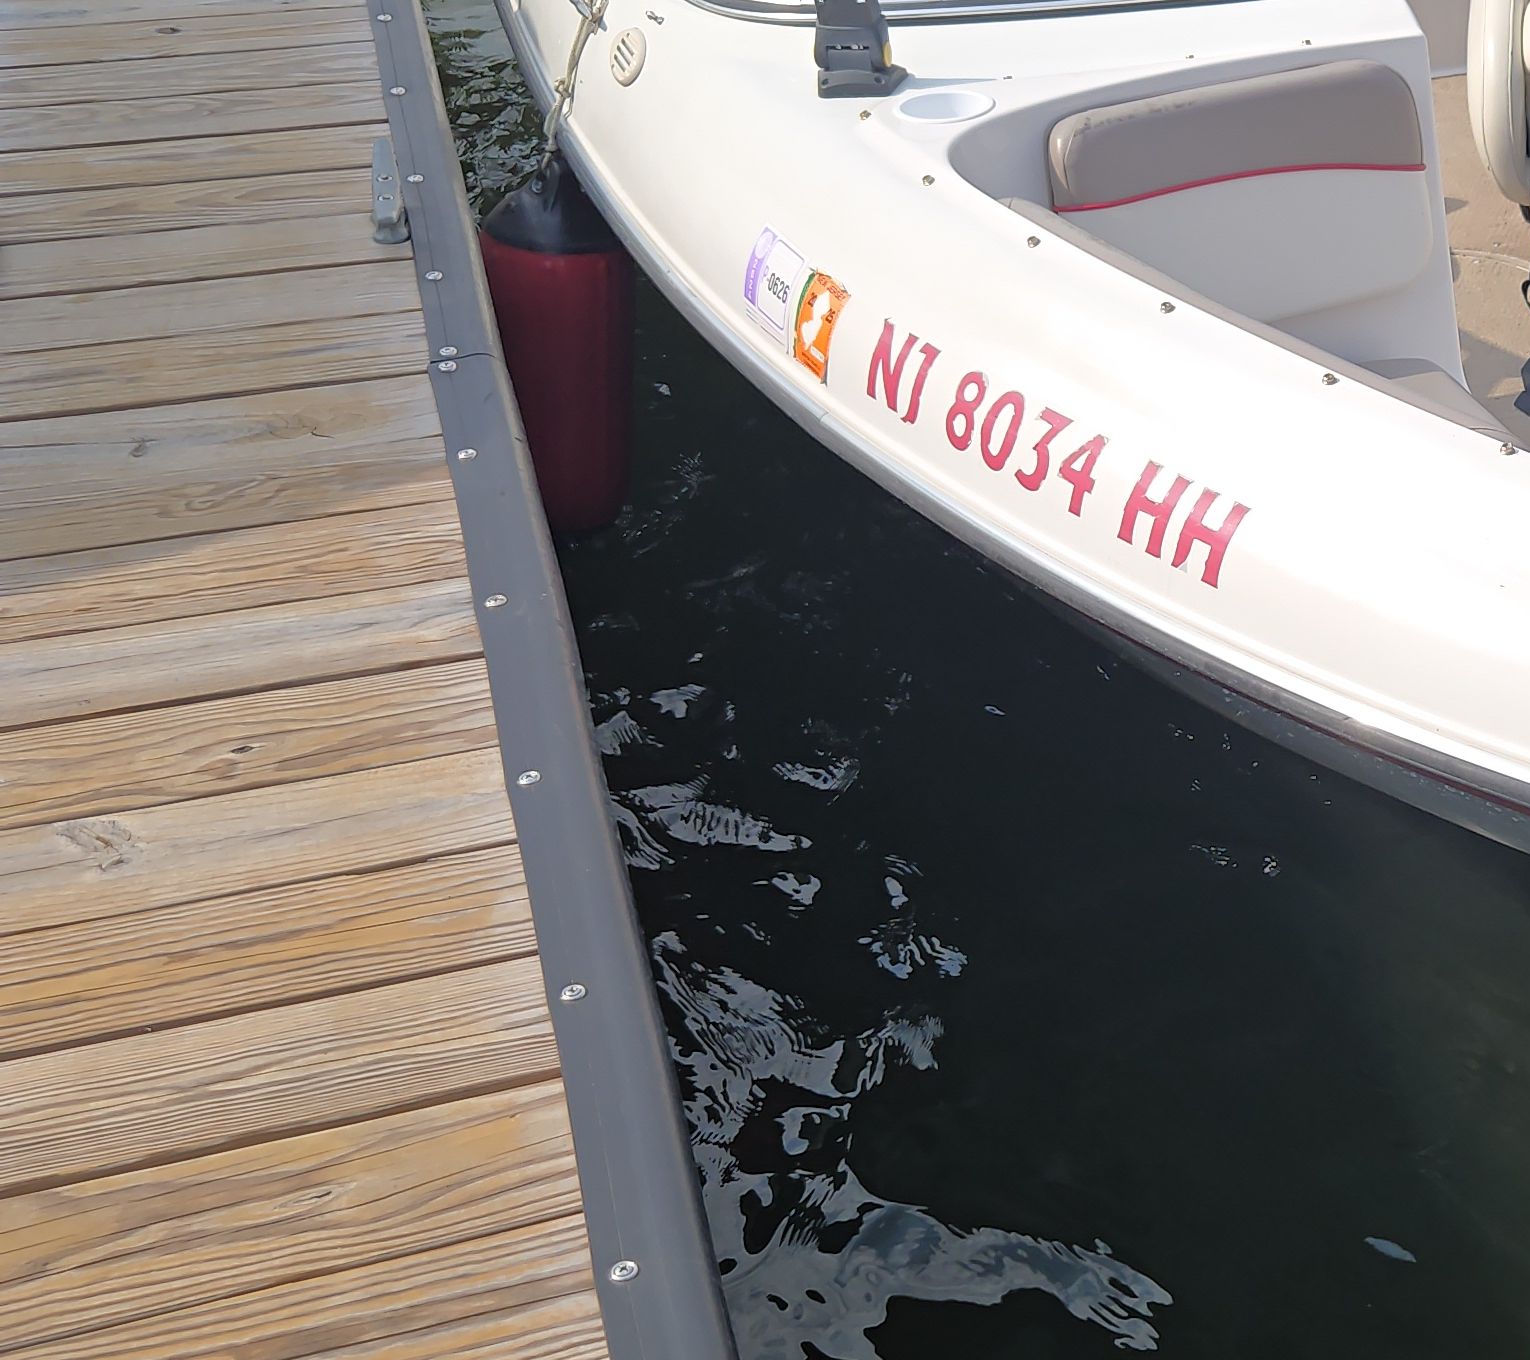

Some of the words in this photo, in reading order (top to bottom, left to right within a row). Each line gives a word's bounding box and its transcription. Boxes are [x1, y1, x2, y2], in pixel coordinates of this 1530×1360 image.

[866, 318, 942, 426] NJ
[945, 370, 1110, 518] 8034
[1116, 458, 1252, 590] HH
